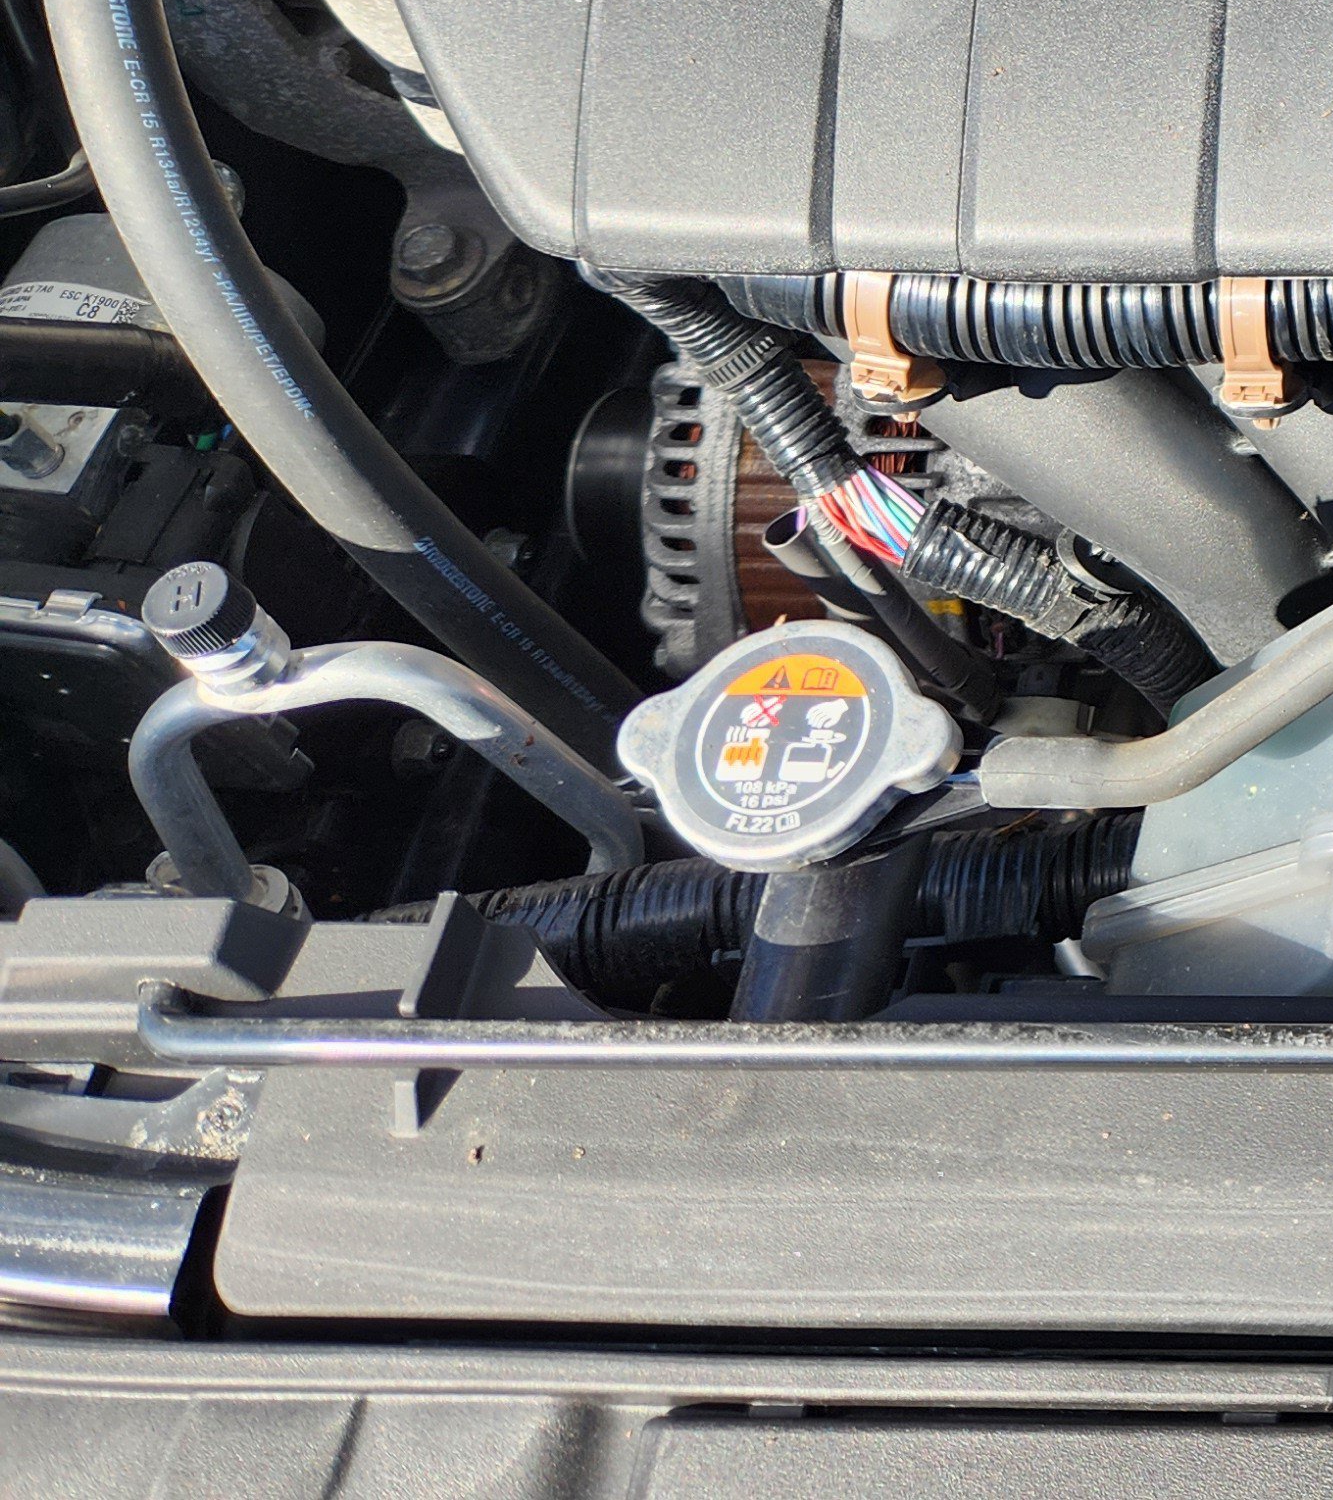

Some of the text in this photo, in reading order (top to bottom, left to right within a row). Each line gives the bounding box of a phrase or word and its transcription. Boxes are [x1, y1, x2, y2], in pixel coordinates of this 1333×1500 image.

[140, 110, 160, 130] 15
[60, 289, 82, 301] ESC
[84, 292, 120, 309] K1900
[76, 302, 101, 320] C8
[764, 780, 797, 796] kPa
[740, 793, 789, 809] 16 psi
[724, 812, 774, 834] FL22
